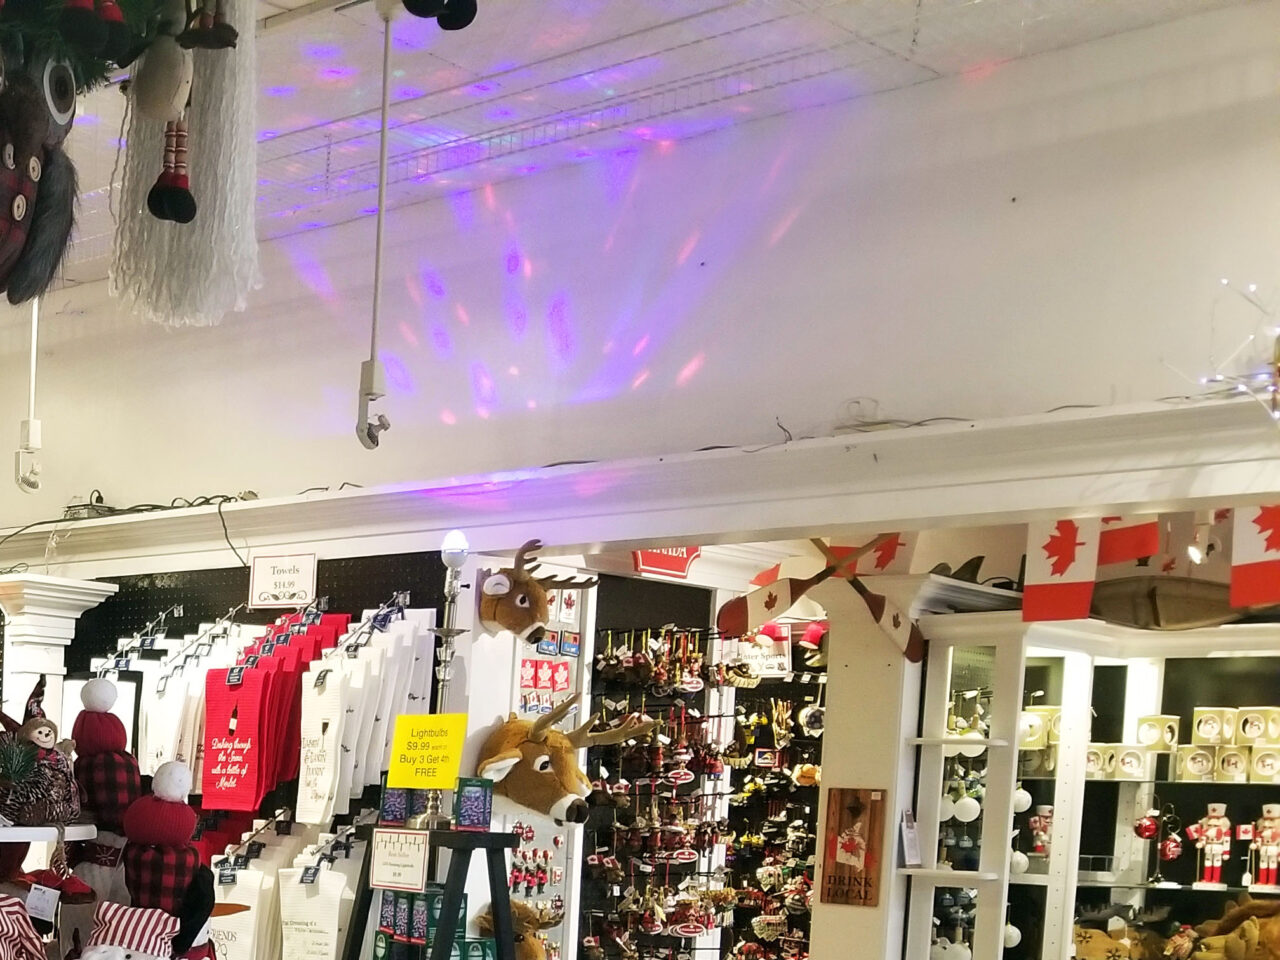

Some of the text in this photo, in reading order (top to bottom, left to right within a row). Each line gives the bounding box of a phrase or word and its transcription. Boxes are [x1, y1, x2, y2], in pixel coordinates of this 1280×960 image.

[270, 565, 300, 575] Towels
[411, 728, 448, 739] Lightbulbs
[406, 741, 430, 751] $9.99
[400, 754, 417, 765] Buy
[419, 755, 425, 764] 3
[426, 755, 440, 764] Get
[415, 768, 437, 777] FREE
[828, 875, 872, 888] DRINK
[828, 887, 872, 900] LOCAL
